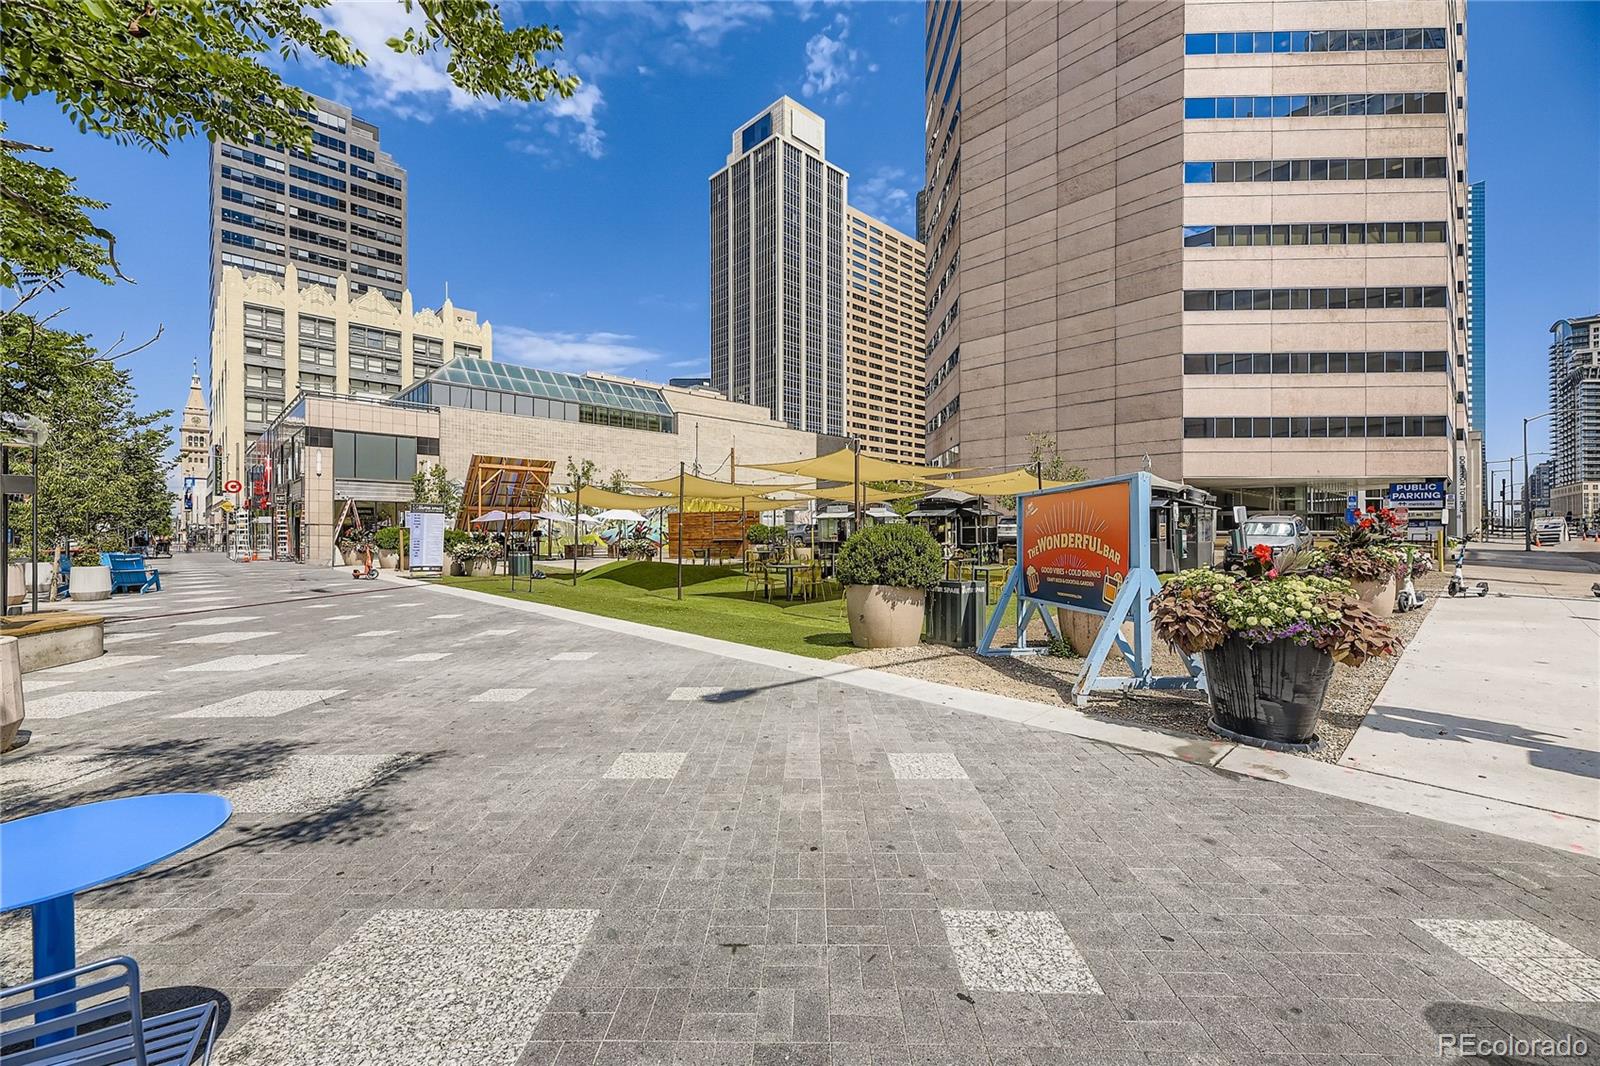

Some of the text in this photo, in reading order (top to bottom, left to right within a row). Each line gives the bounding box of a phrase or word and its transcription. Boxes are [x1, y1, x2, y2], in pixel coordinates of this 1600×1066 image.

[1396, 483, 1437, 491] PUBLIC
[1392, 491, 1441, 500] PARKING
[1027, 533, 1121, 565] THE WONDERFUL BAR
[1068, 568, 1081, 577] COLD
[1081, 569, 1102, 578] DRINKS
